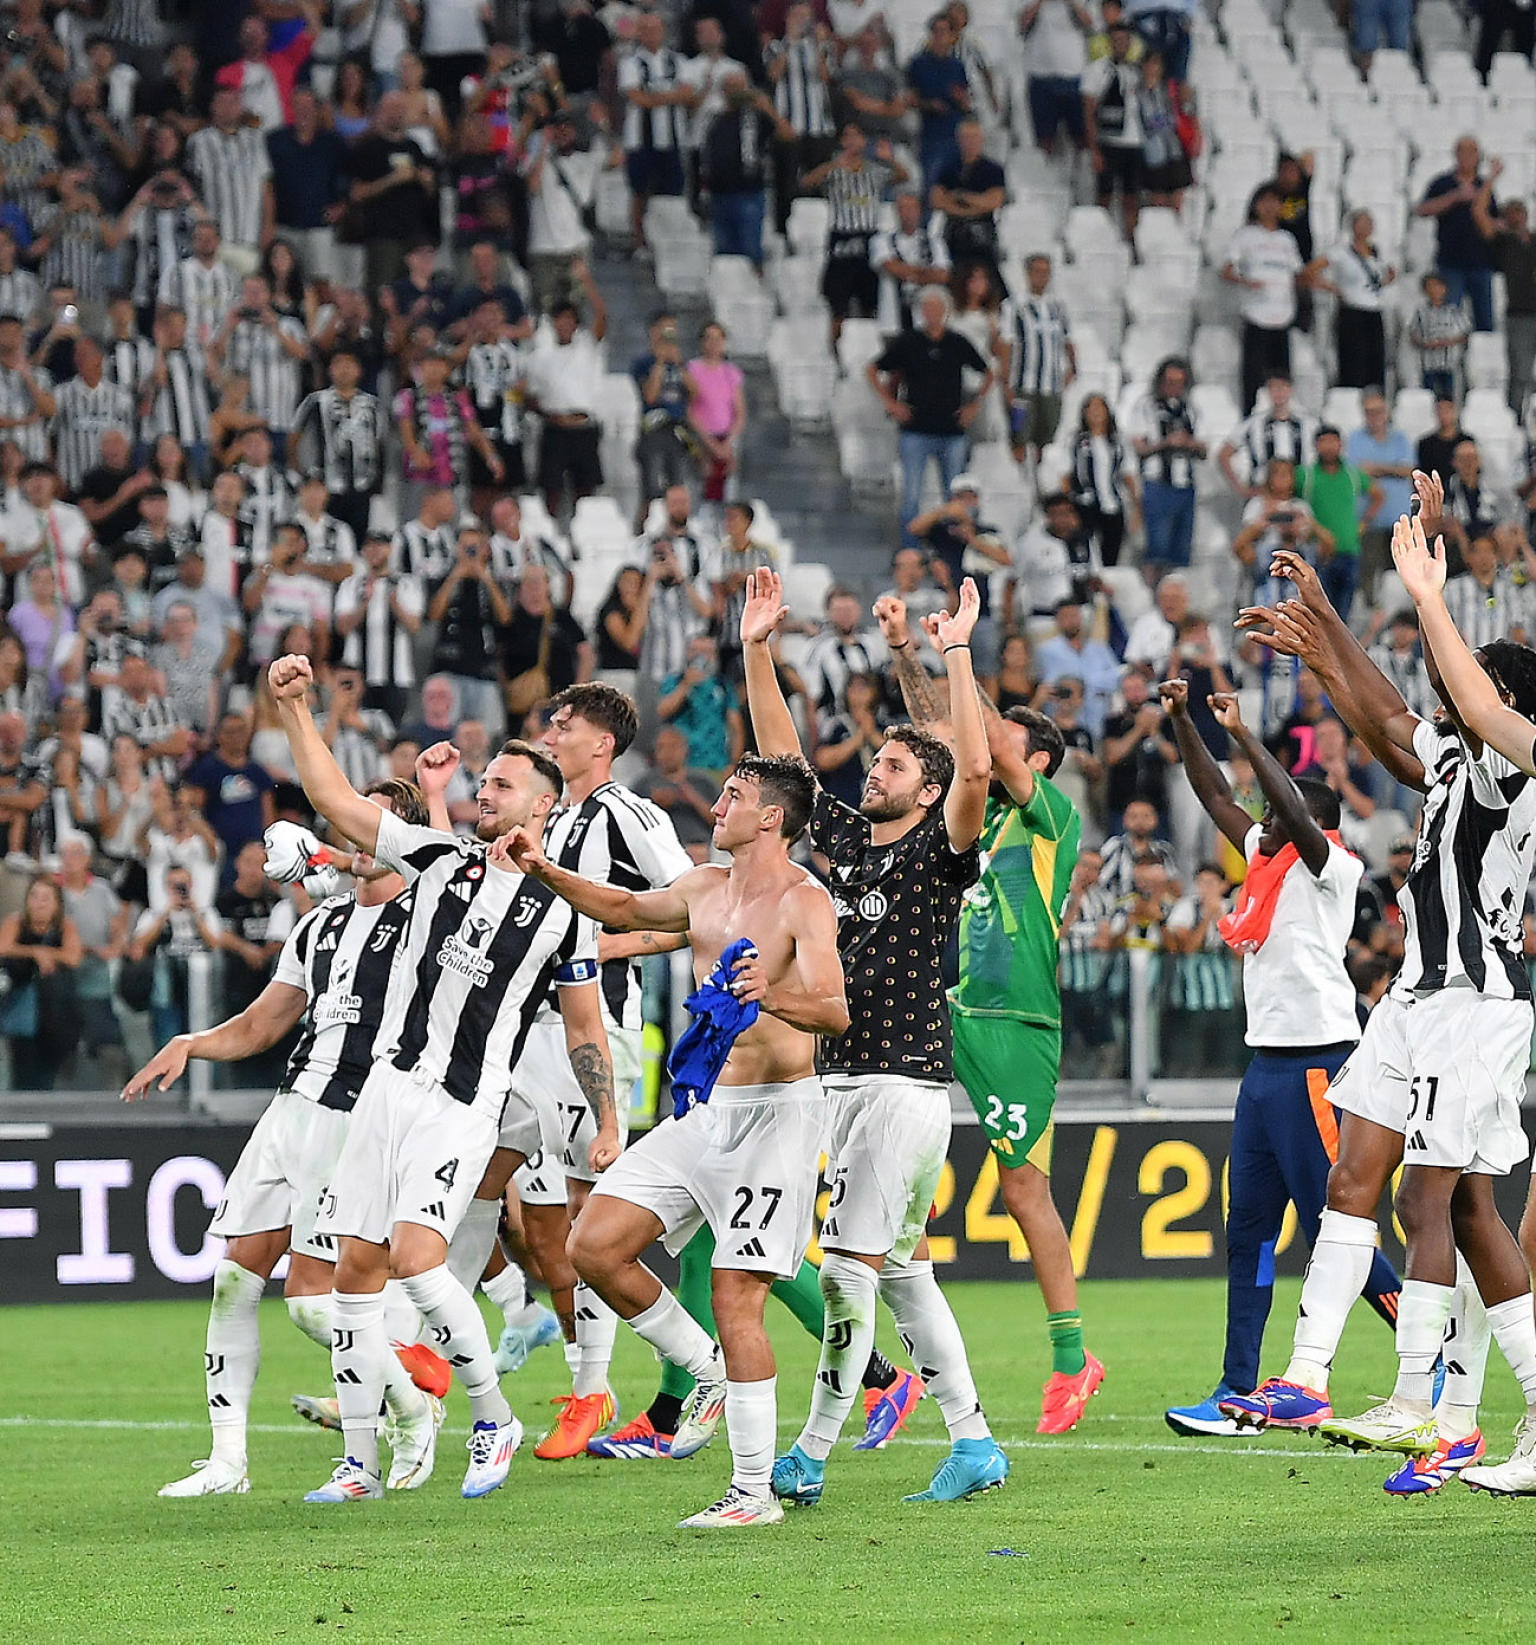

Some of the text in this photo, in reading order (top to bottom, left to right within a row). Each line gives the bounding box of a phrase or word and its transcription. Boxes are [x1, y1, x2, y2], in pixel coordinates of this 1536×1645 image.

[438, 951, 486, 985] Children
[984, 1094, 1028, 1141] 23
[1406, 1075, 1439, 1121] 51
[434, 1157, 460, 1194] 4
[729, 1185, 784, 1232] 27
